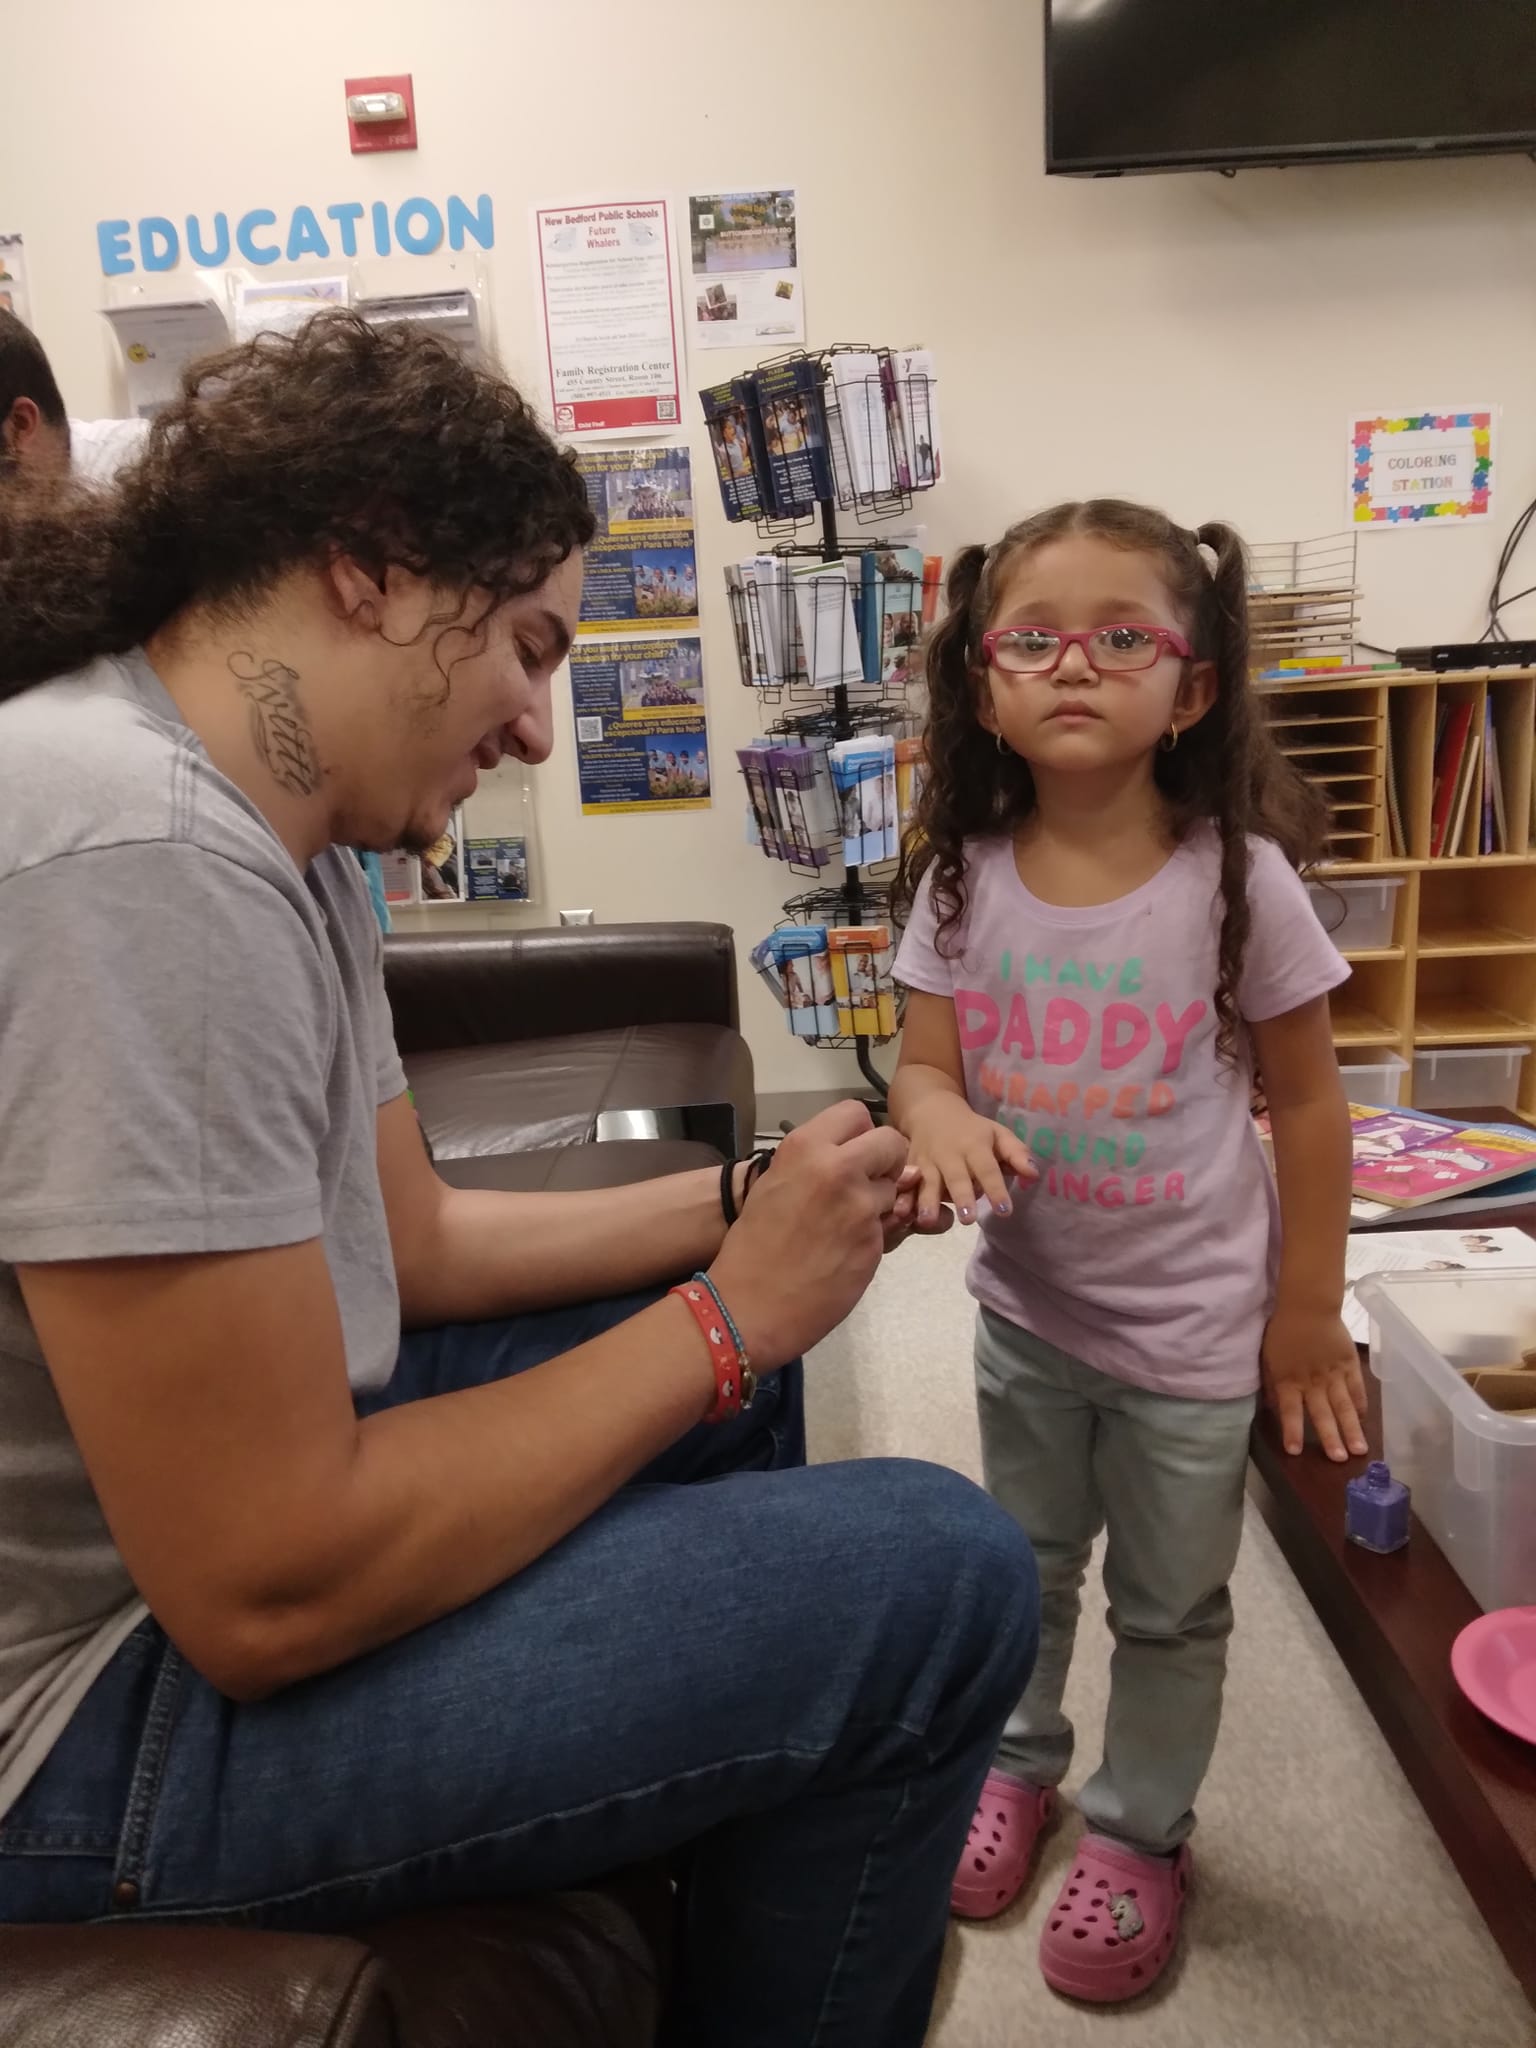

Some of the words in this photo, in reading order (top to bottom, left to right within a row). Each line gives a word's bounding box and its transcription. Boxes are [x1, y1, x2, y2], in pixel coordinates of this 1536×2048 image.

[544, 217, 563, 226] New
[565, 212, 596, 225] Bedford
[599, 210, 624, 221] Public
[626, 208, 659, 219] Schools
[96, 193, 495, 277] EDUCATION
[588, 226, 617, 236] Future
[586, 238, 621, 249] Whalers
[555, 367, 585, 379] Family
[587, 363, 640, 376] Registration
[641, 361, 671, 372] Center
[611, 462, 631, 474] your
[1388, 454, 1457, 470] COLORING
[1392, 476, 1453, 492] STATION
[583, 644, 598, 655] you
[599, 643, 619, 654] want
[620, 643, 631, 652] an
[632, 640, 678, 652] exceptional
[570, 653, 610, 664] education
[611, 652, 622, 661] for
[623, 651, 642, 662] your
[644, 649, 669, 660] child?
[604, 727, 655, 739] excepcional?
[656, 726, 676, 736] Para
[687, 724, 706, 735] hijo?
[607, 720, 643, 732] ¿Quieres
[644, 719, 660, 727] una
[661, 717, 701, 727] educación
[1000, 950, 1012, 981] I
[1024, 954, 1144, 995] HAVE
[953, 988, 1208, 1075] DADDY
[979, 1063, 1177, 1120] WRAPPED
